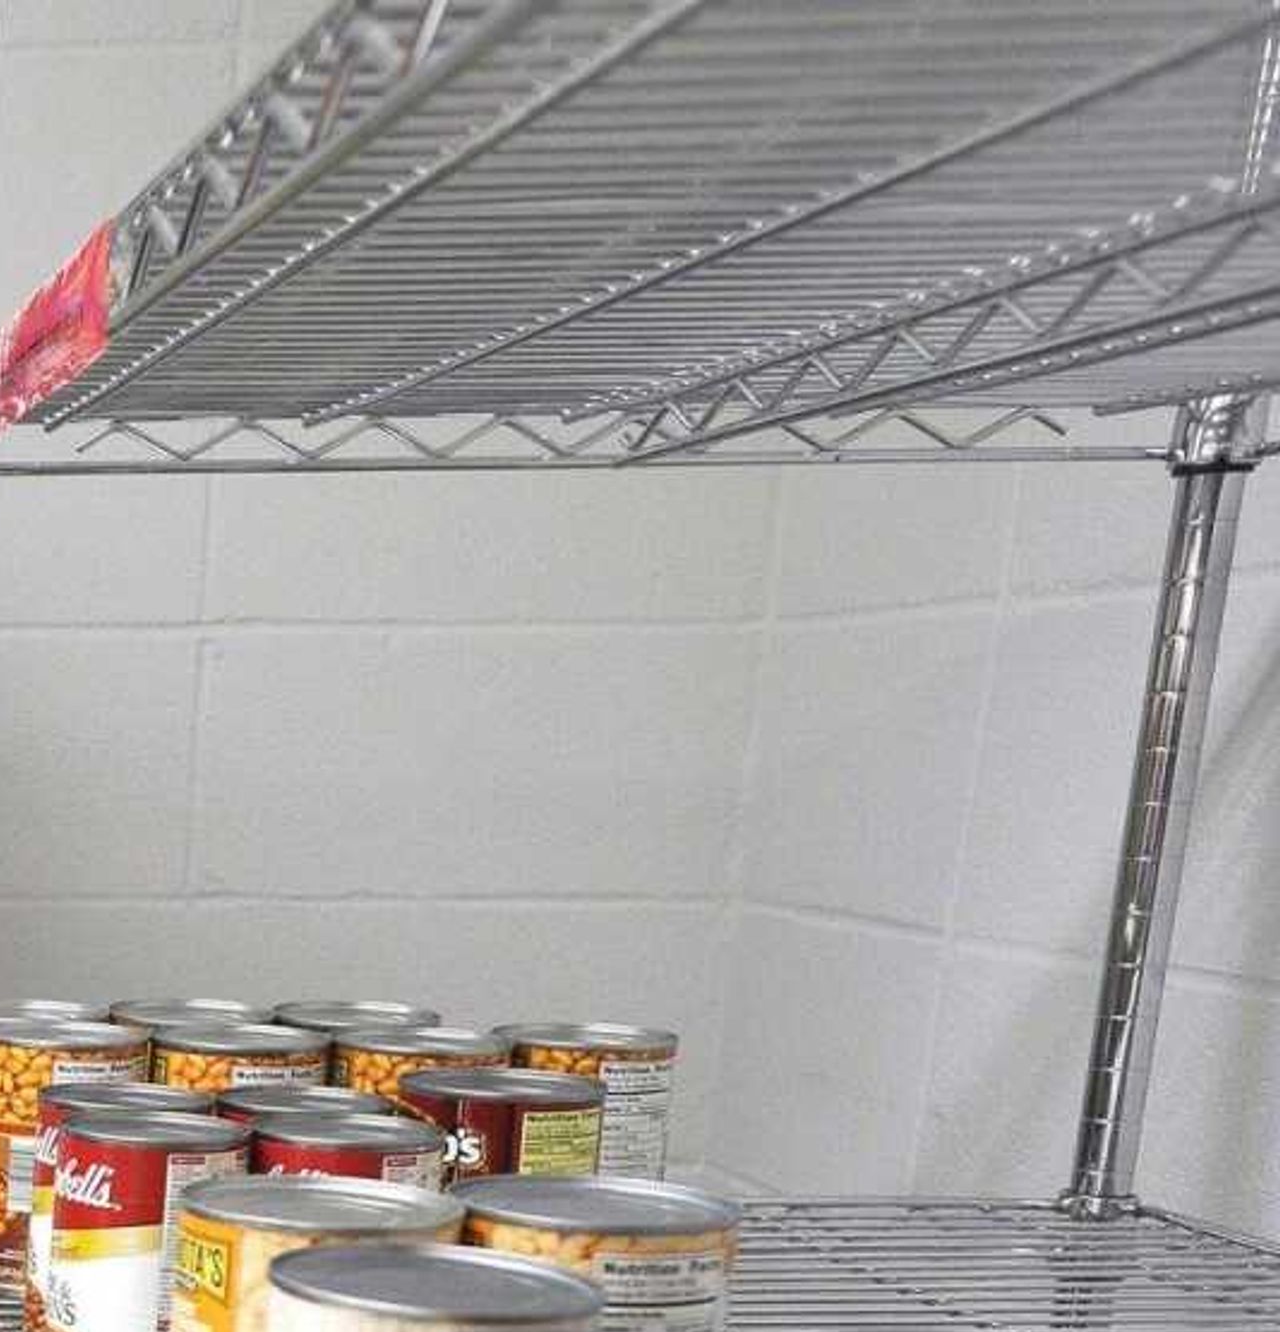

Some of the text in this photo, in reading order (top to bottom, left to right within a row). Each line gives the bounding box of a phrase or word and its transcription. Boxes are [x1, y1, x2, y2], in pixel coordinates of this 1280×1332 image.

[57, 1063, 107, 1074] Nutrition
[605, 1066, 653, 1077] Nutrition
[236, 1070, 286, 1080] Nutrition
[527, 1112, 573, 1125] Nutrition
[53, 1158, 116, 1210] bell's
[603, 1262, 681, 1276] Nutrition
